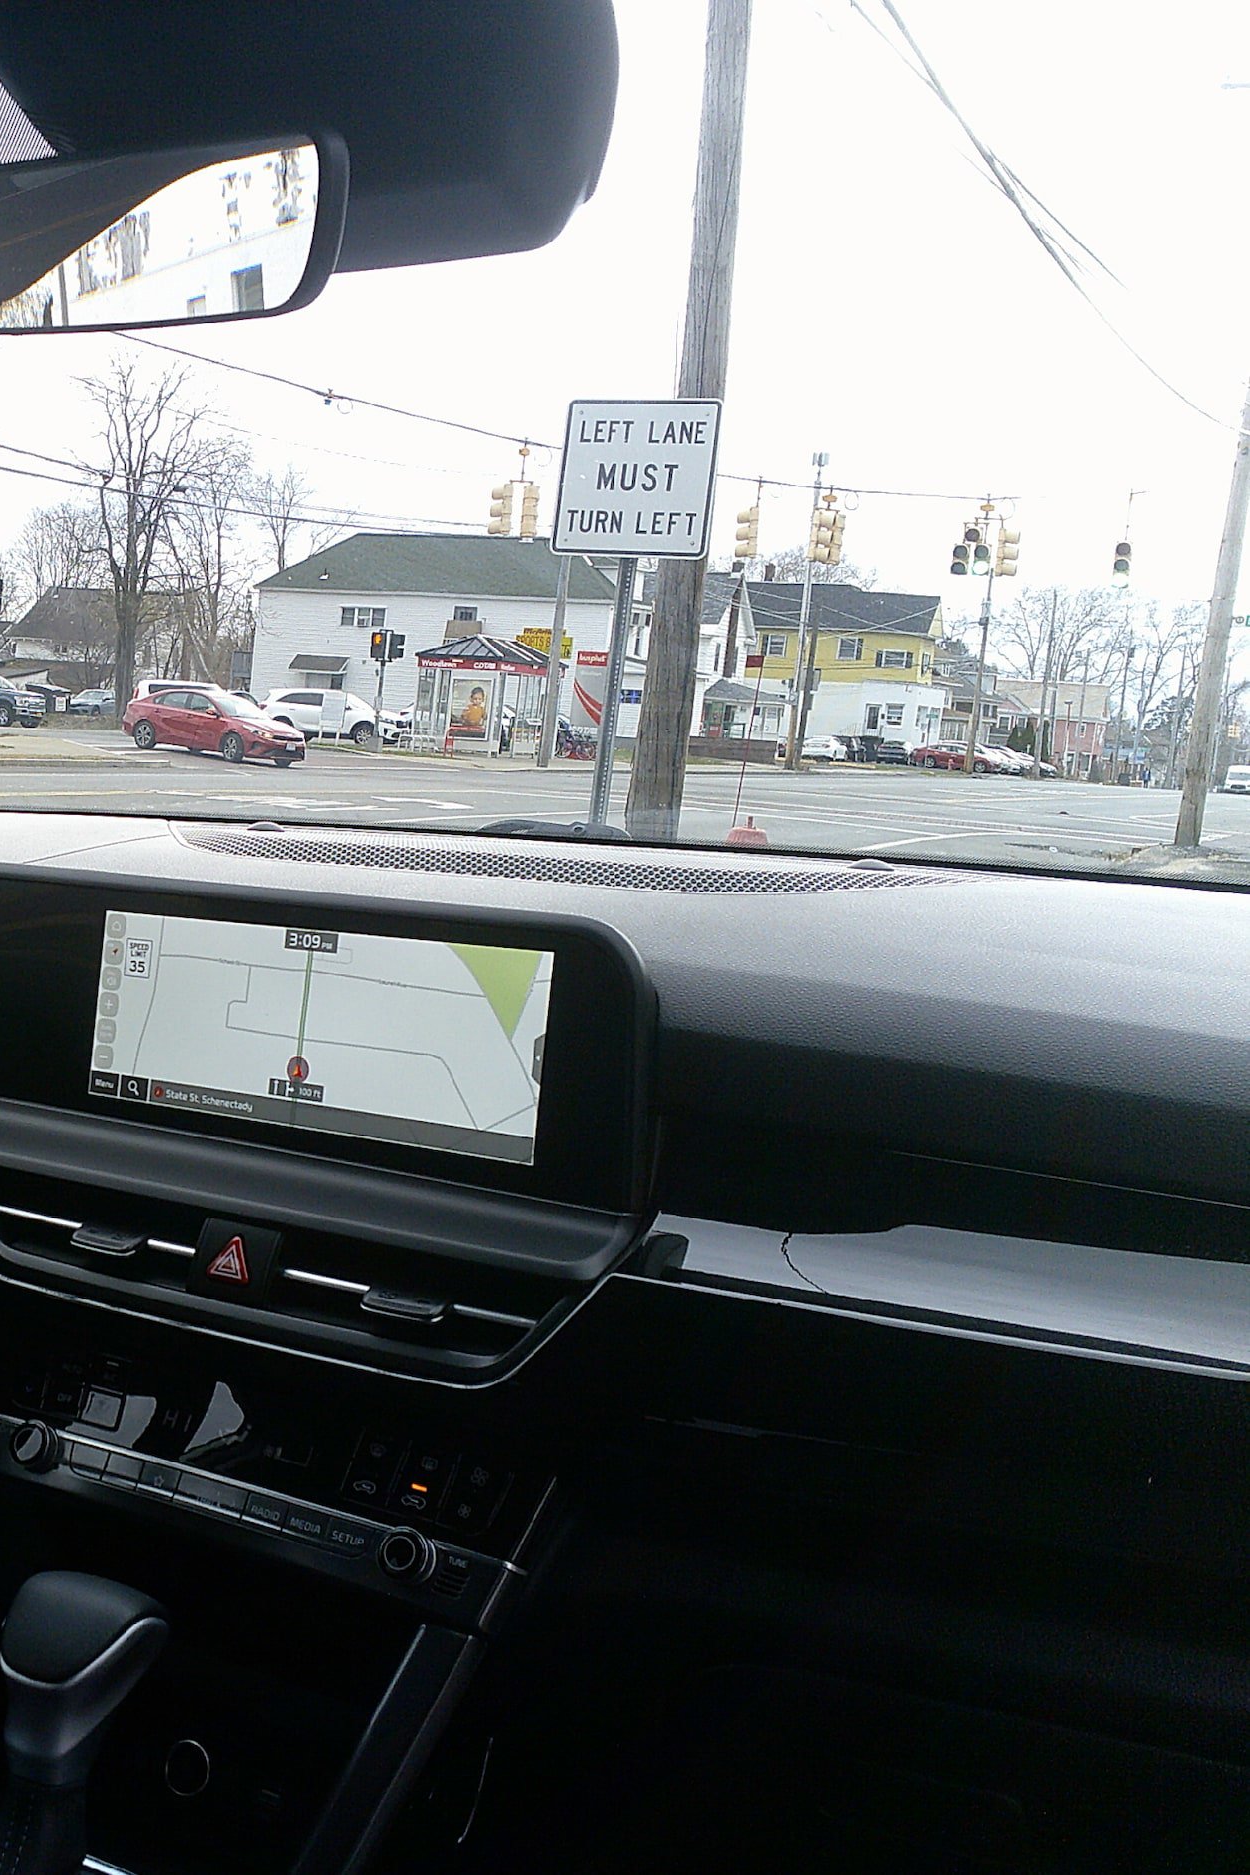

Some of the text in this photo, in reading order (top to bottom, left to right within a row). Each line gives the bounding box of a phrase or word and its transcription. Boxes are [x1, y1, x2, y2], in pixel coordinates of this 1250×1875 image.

[579, 420, 708, 445] LEFT LANE
[596, 462, 679, 492] MUST
[567, 509, 697, 536] TURN LEFT
[129, 942, 150, 951] SPEED
[288, 932, 322, 949] 3:09
[128, 960, 146, 973] 35
[165, 1089, 188, 1102] State
[201, 1094, 254, 1113] Schenectady
[250, 1504, 366, 1547] RADIO MEDIA SETUP
